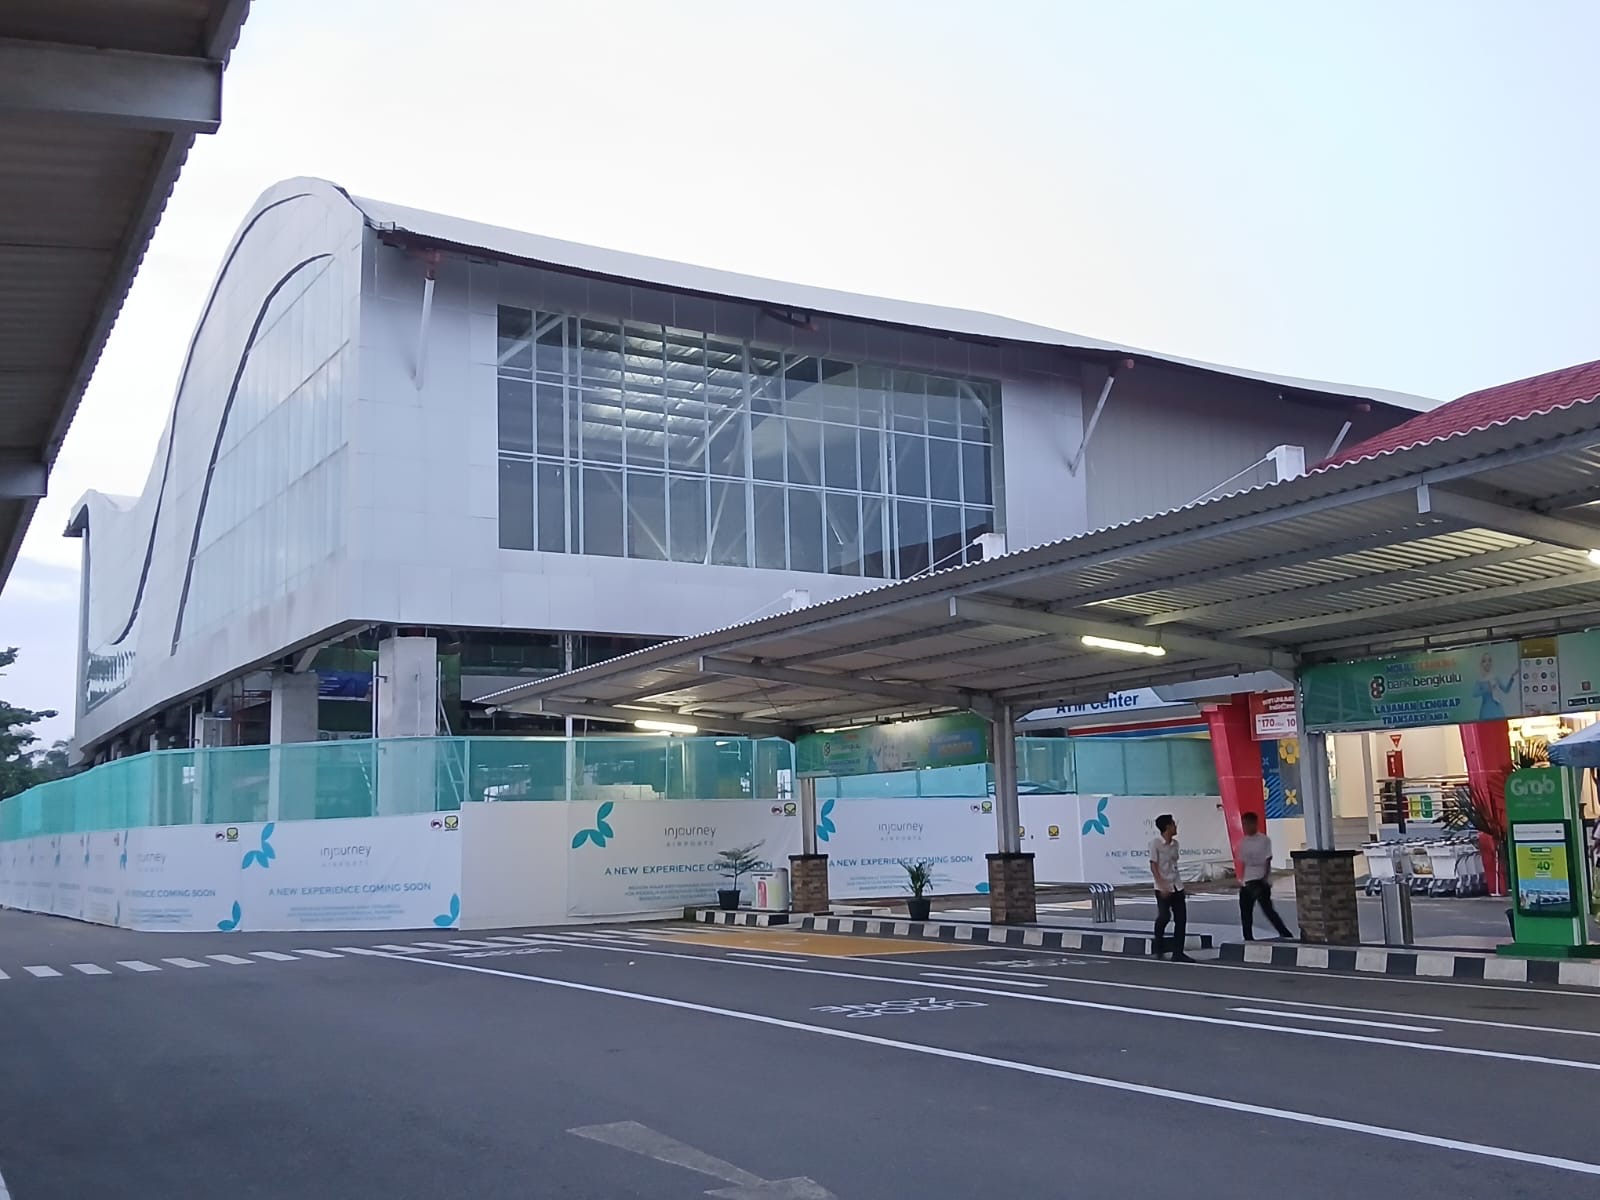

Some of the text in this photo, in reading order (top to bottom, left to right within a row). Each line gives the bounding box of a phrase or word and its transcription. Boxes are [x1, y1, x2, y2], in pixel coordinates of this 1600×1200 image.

[1413, 672, 1462, 688] bengkulu
[1262, 718, 1275, 728] 170
[1510, 774, 1556, 796] Grab
[664, 825, 717, 840] injourney
[878, 822, 924, 835] injourney
[320, 844, 372, 860] injourney
[829, 854, 973, 868] A NEW EXPERIENCE COMING SOON
[1536, 860, 1551, 871] 40
[604, 866, 612, 876] A
[614, 865, 639, 875] NEW
[642, 863, 705, 875] EXPERIENCE
[192, 888, 216, 897] SOON
[268, 881, 432, 897] A NEW EXPERIENCE COMING SOON
